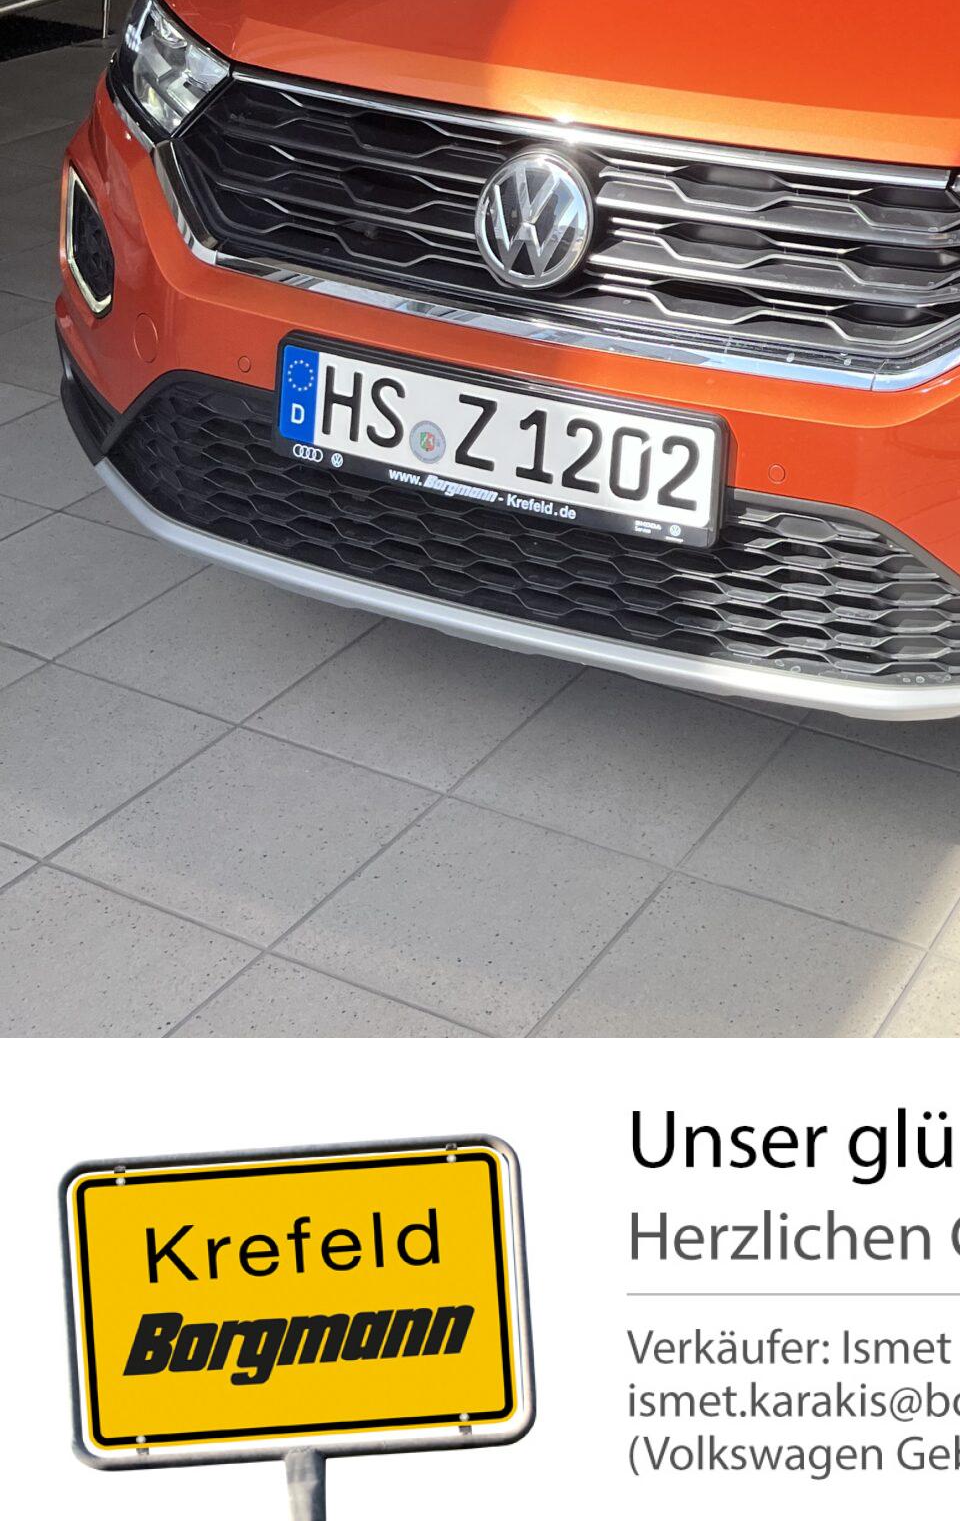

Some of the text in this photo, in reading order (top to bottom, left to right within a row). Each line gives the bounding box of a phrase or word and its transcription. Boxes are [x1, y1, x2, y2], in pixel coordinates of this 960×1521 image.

[321, 365, 406, 448] HS
[454, 393, 498, 472] Z
[515, 409, 700, 512] 1202
